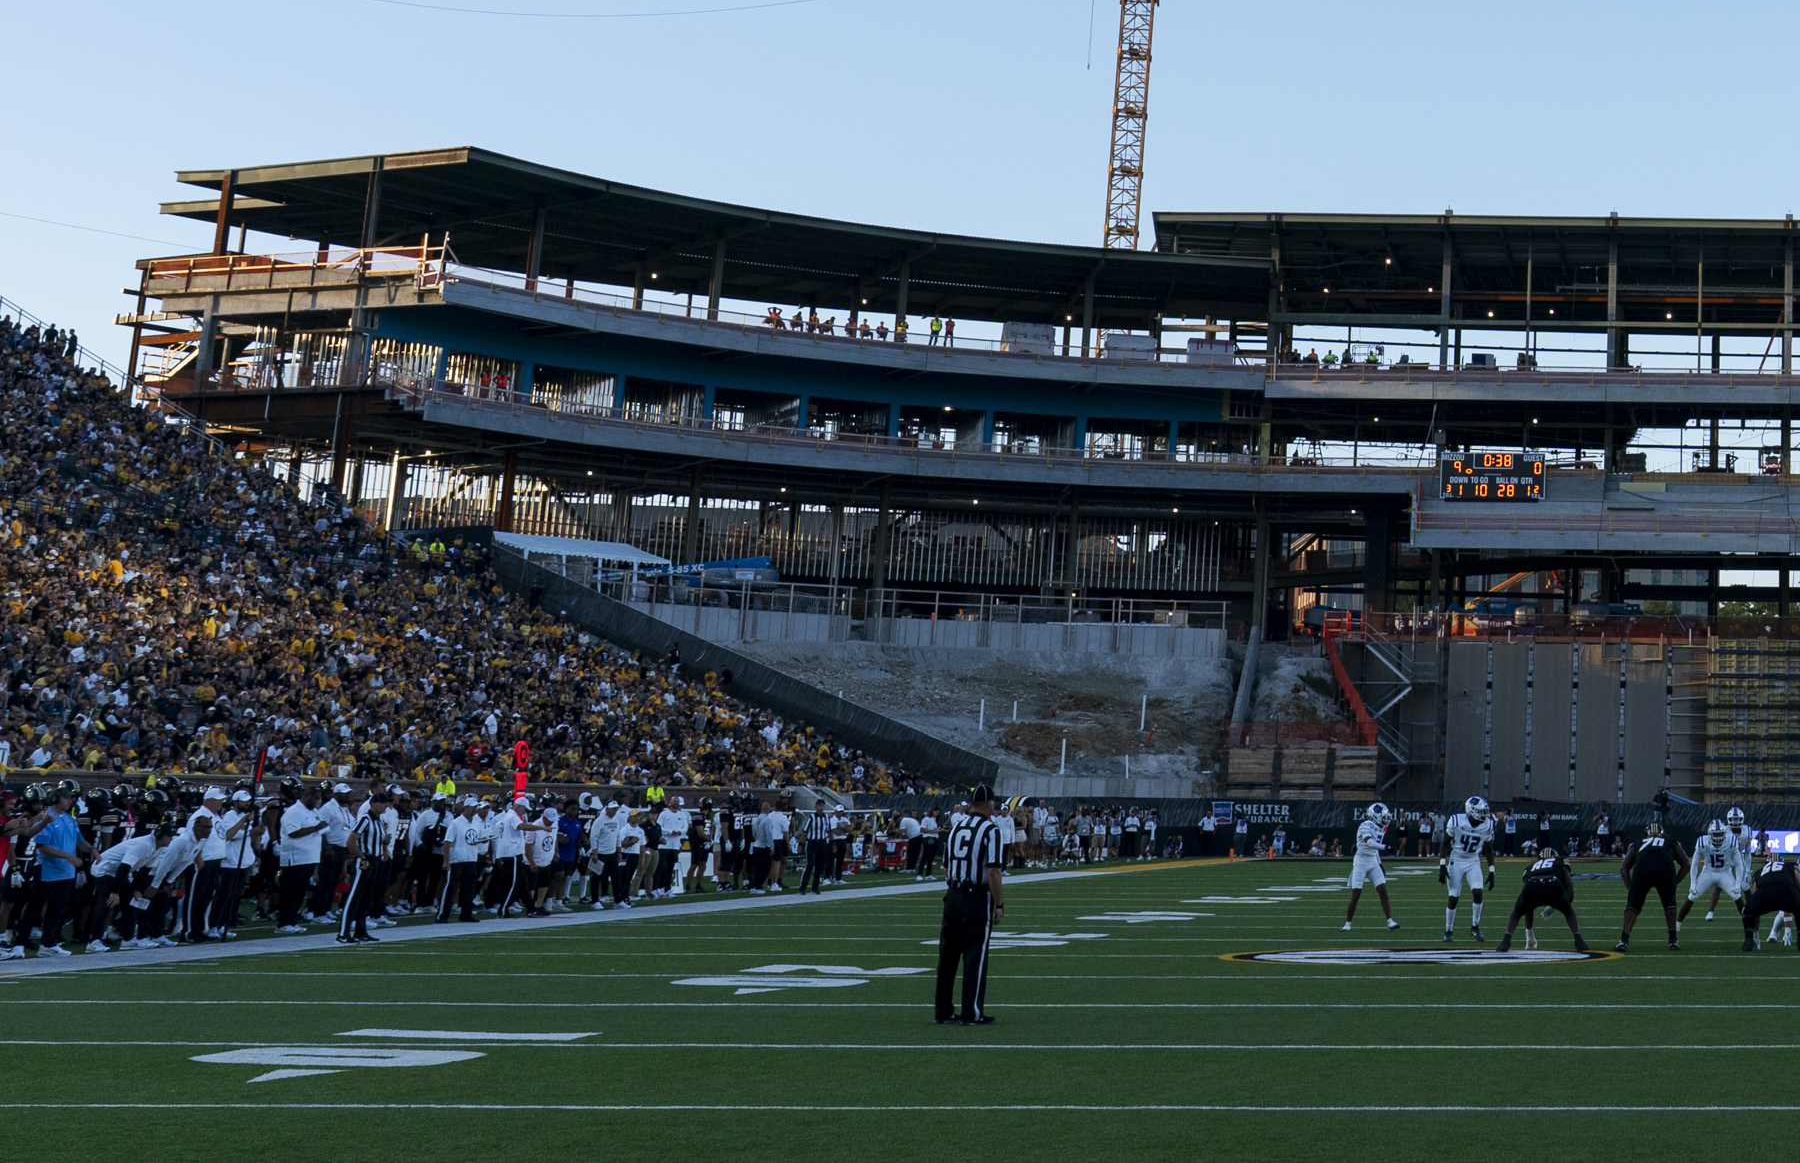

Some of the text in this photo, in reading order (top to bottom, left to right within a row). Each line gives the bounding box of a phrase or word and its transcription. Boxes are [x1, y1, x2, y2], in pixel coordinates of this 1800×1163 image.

[1442, 453, 1465, 461] MIZZOU
[1484, 454, 1512, 467] 0:38
[1453, 461, 1542, 475] 9 0
[1449, 476, 1468, 484] DOWN
[1471, 476, 1479, 484] TO
[1459, 484, 1463, 496] 1
[1475, 484, 1488, 497] 10
[1497, 484, 1515, 497] 28
[1527, 485, 1531, 496] 1
[690, 564, 705, 572] XC
[1235, 804, 1290, 815] SHELTER
[953, 829, 972, 858] C
[1461, 834, 1481, 853] 42
[1710, 854, 1724, 868] 15
